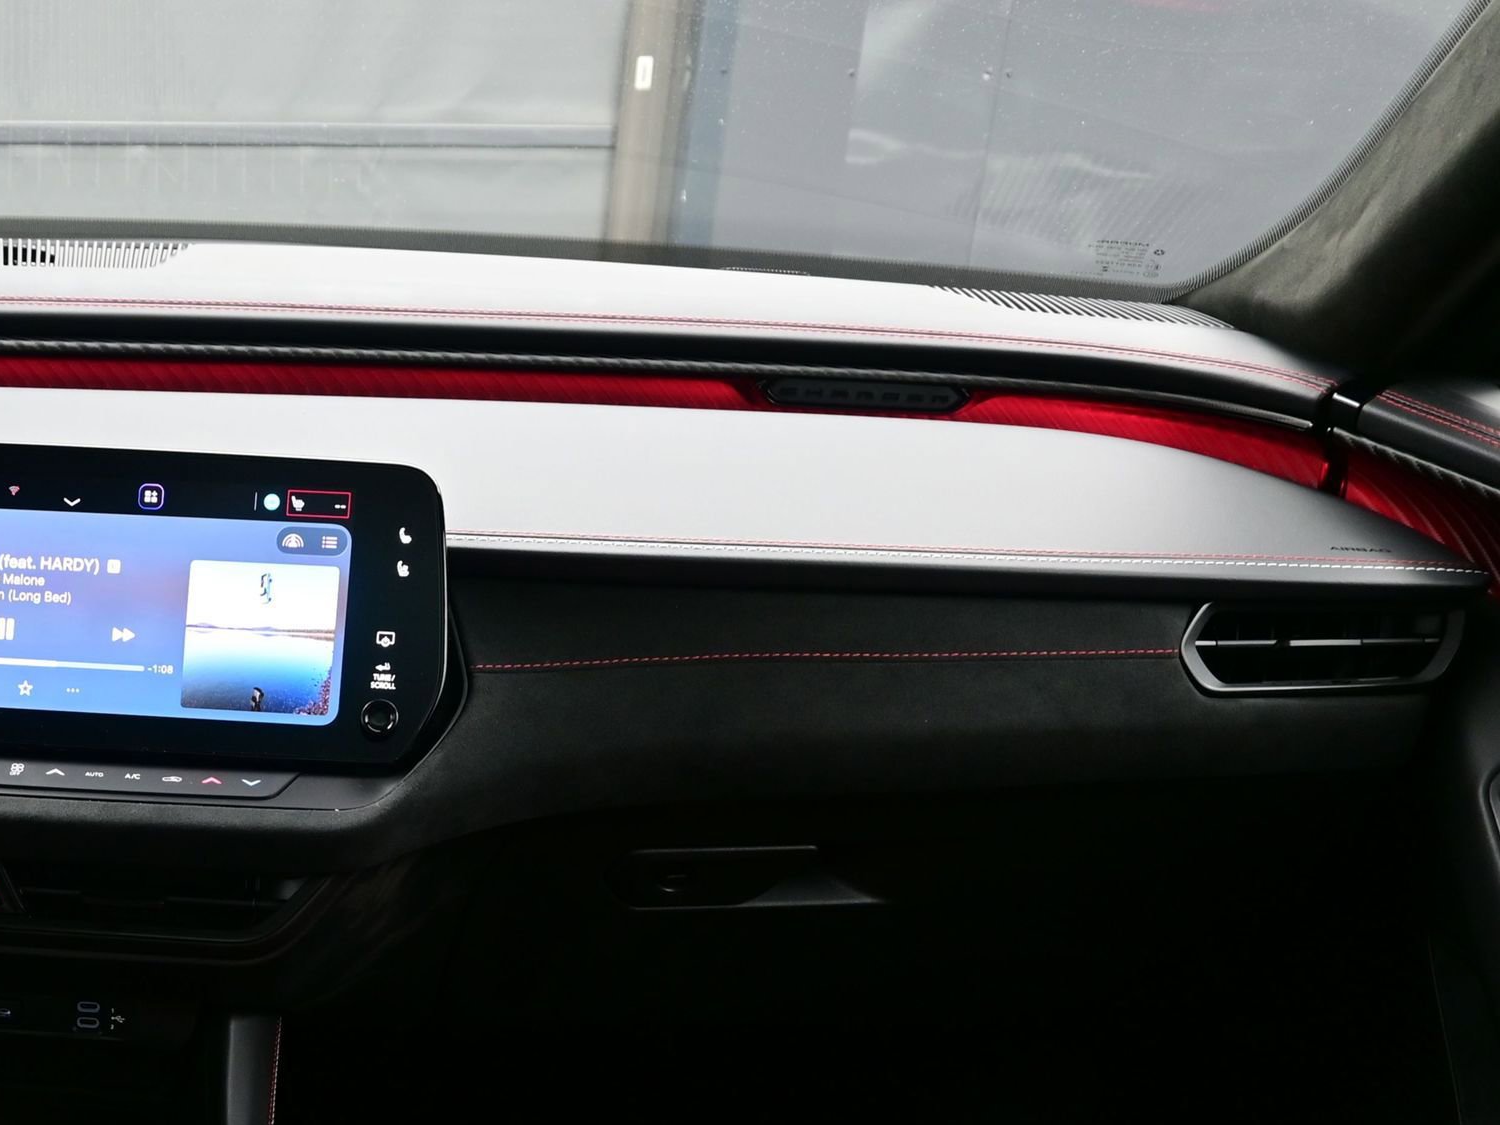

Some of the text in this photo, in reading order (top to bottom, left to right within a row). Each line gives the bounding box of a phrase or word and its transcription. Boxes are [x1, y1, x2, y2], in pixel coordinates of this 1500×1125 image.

[1329, 545, 1393, 553] AIRBAG
[40, 556, 100, 576] HARDY)
[3, 572, 45, 587] Malone
[8, 589, 41, 605] (Long
[44, 591, 72, 606] Bed)
[370, 681, 396, 690] SCROLL
